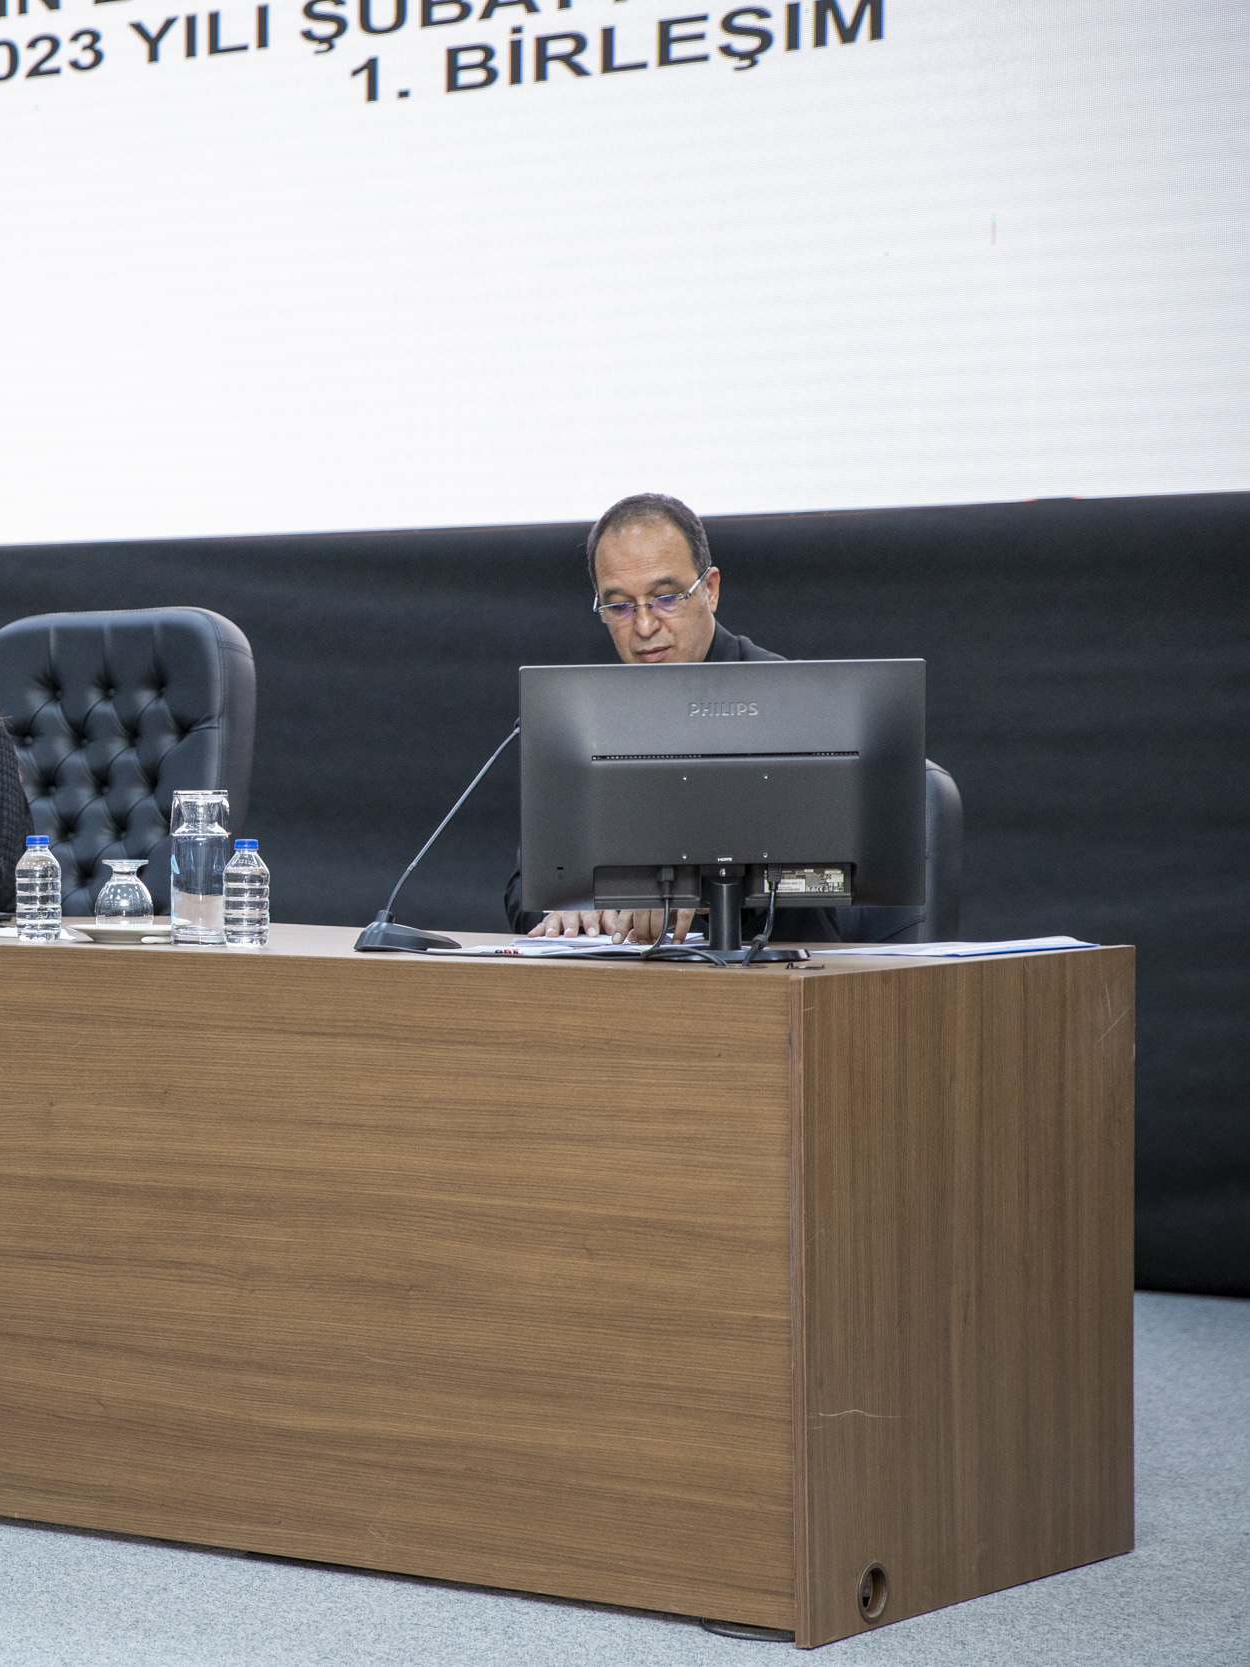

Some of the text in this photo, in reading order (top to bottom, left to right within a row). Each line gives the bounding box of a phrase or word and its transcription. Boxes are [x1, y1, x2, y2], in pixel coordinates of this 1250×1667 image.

[130, 4, 269, 63] YILI
[351, 57, 410, 102] 1.
[688, 702, 759, 717] PHILIPS
